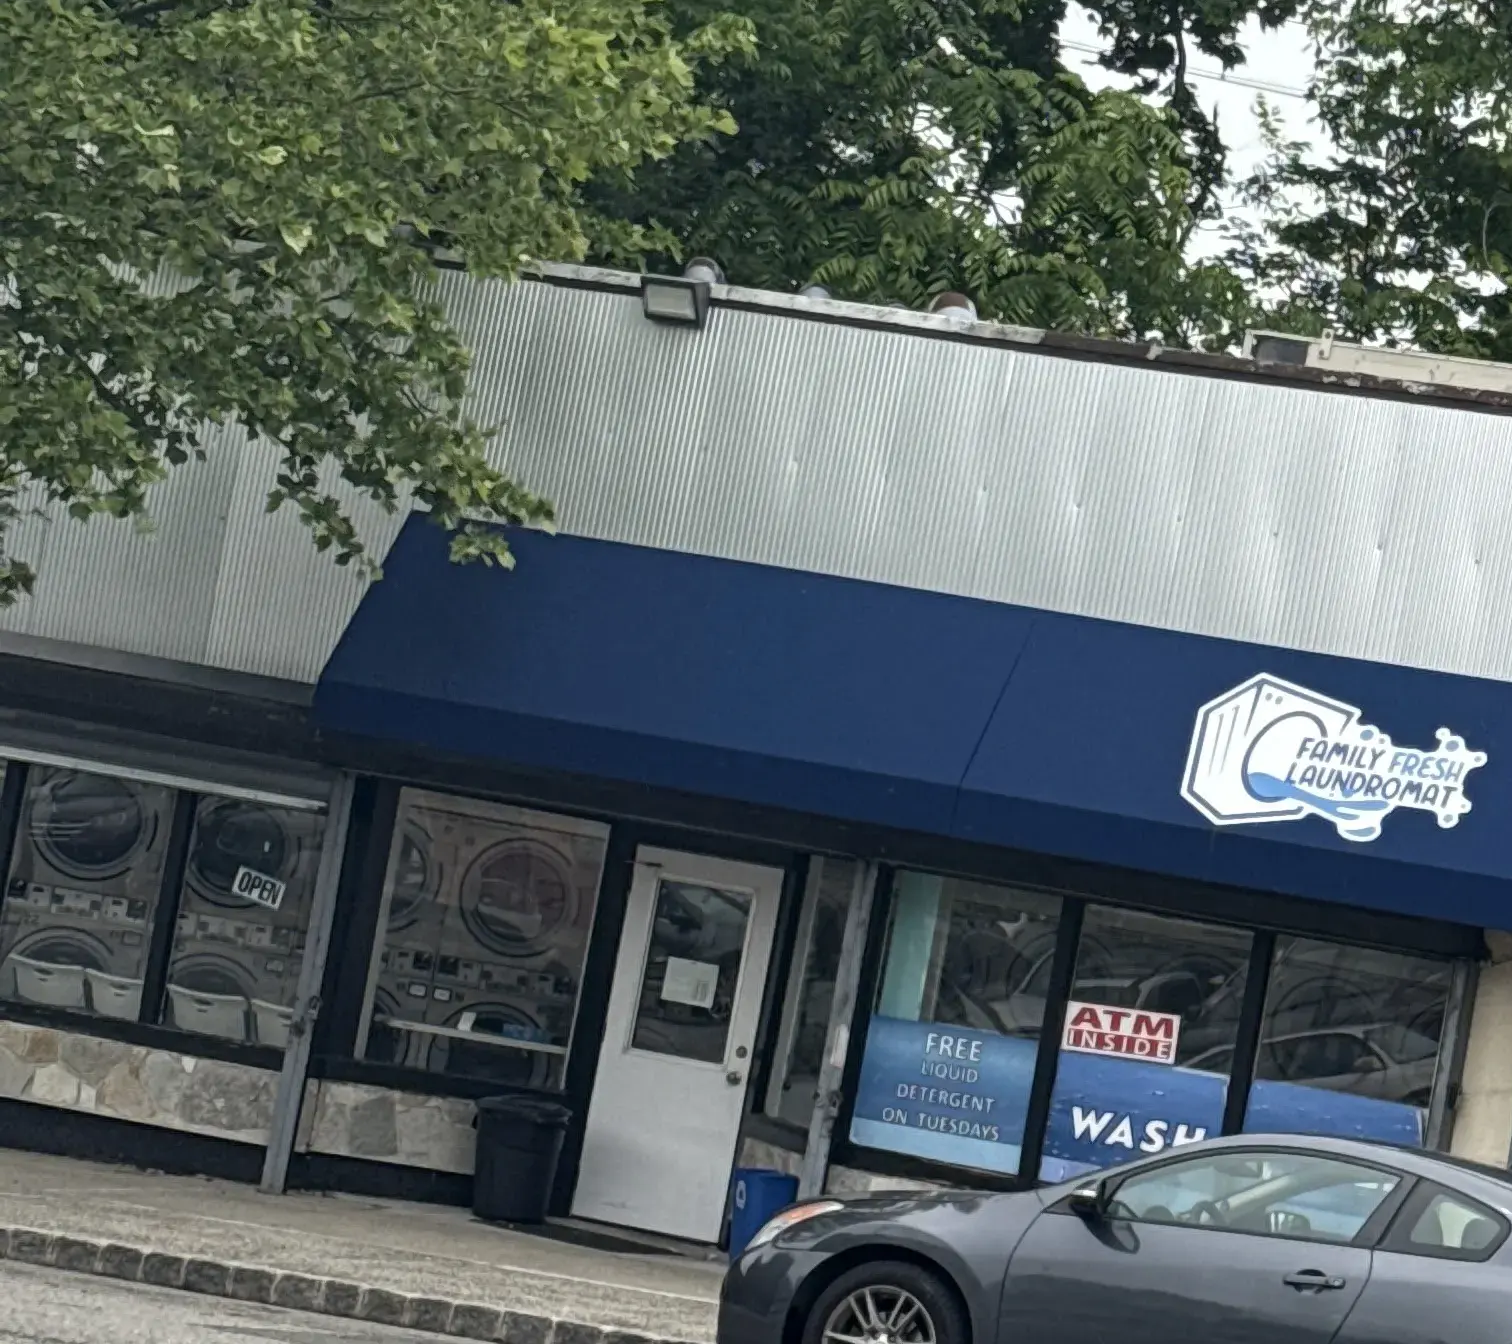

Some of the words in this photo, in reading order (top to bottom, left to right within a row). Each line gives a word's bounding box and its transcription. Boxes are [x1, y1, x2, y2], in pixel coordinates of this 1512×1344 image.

[1296, 737, 1386, 771] FAMILY
[1388, 752, 1465, 783] FRESH
[1284, 762, 1458, 808] LAUNDROMAT
[1070, 1007, 1174, 1039] ATM
[925, 1033, 982, 1062] FREE
[1069, 1028, 1171, 1060] INSIDE
[921, 1060, 978, 1083] LIQUID
[897, 1083, 995, 1113] DETERGENT
[882, 1107, 907, 1125] ON
[919, 1113, 999, 1141] TUESDAYS
[1072, 1106, 1206, 1153] WASH
